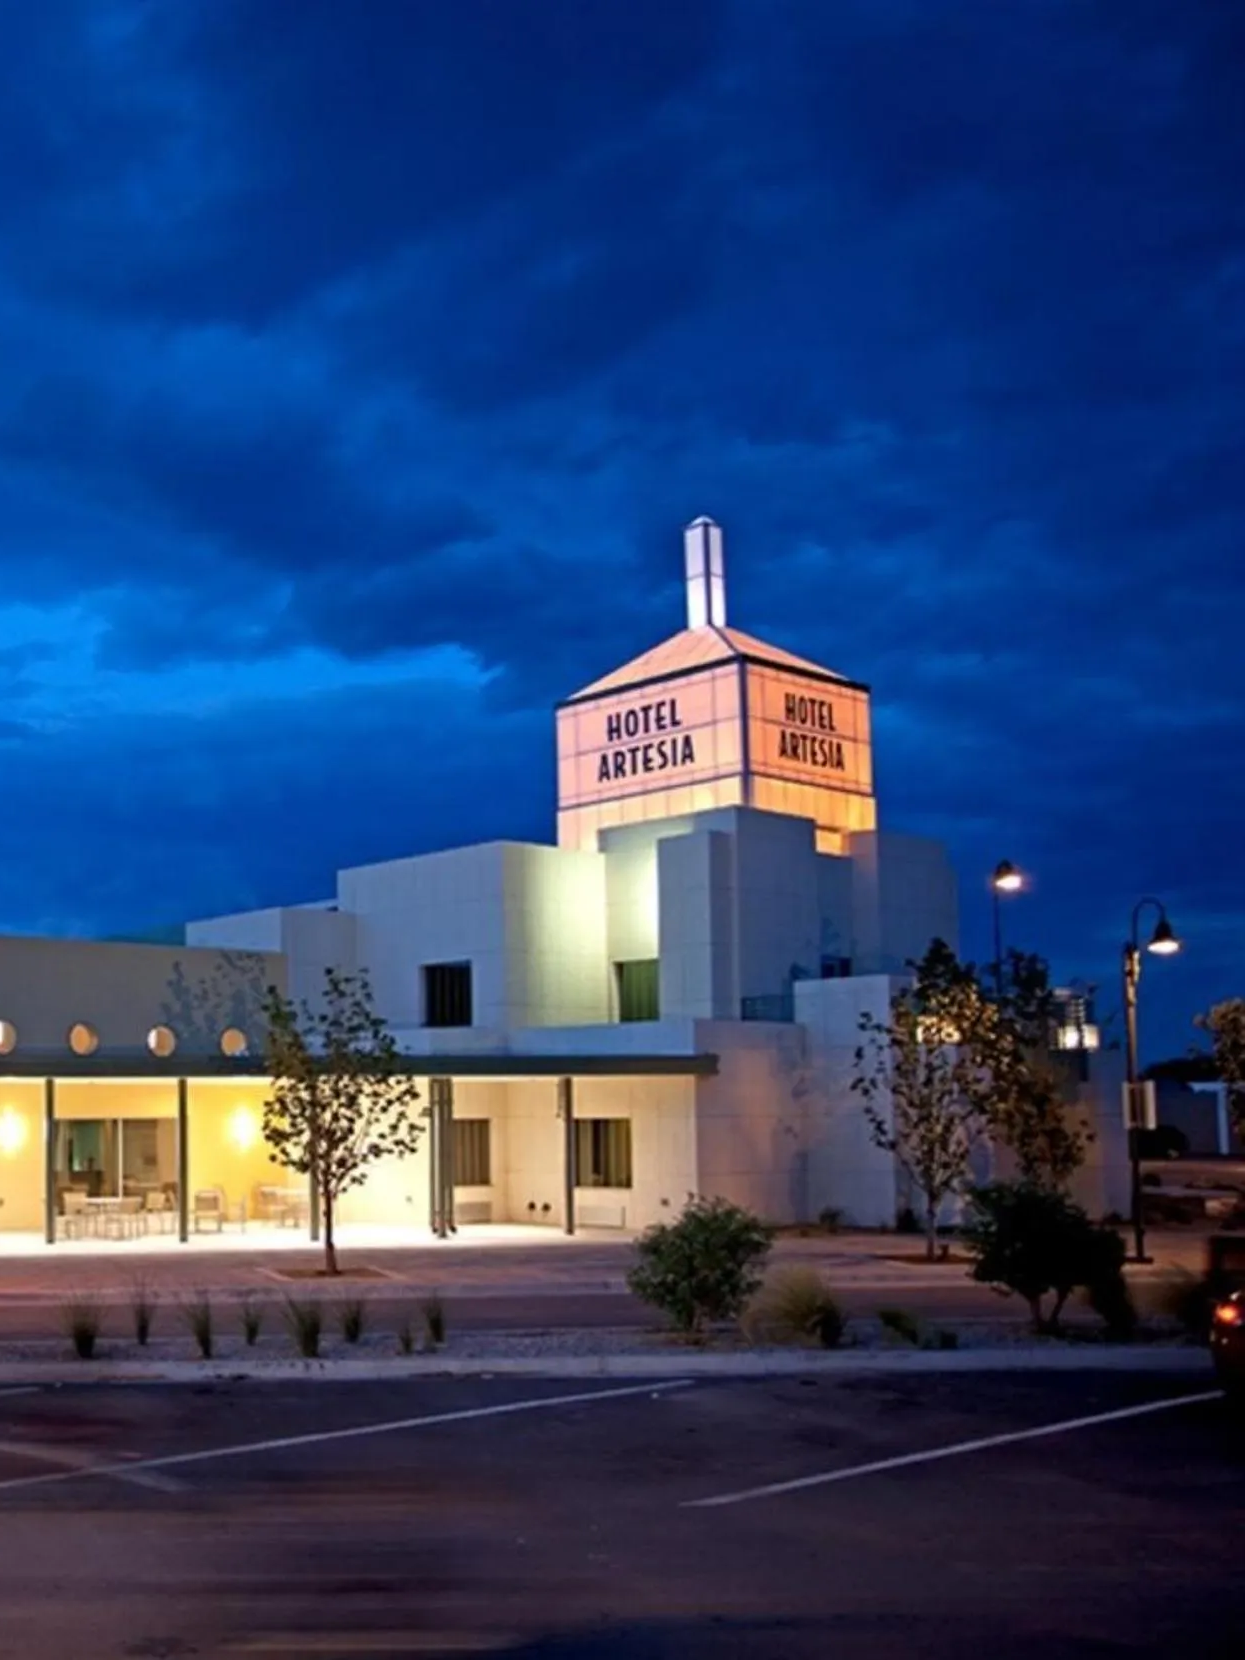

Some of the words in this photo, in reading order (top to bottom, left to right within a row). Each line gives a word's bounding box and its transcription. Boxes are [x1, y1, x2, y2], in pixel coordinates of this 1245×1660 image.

[607, 699, 681, 741] HOTEL
[785, 693, 836, 731] HOTEL
[598, 735, 695, 782] ARTESIA
[779, 731, 844, 770] ARTESIA
